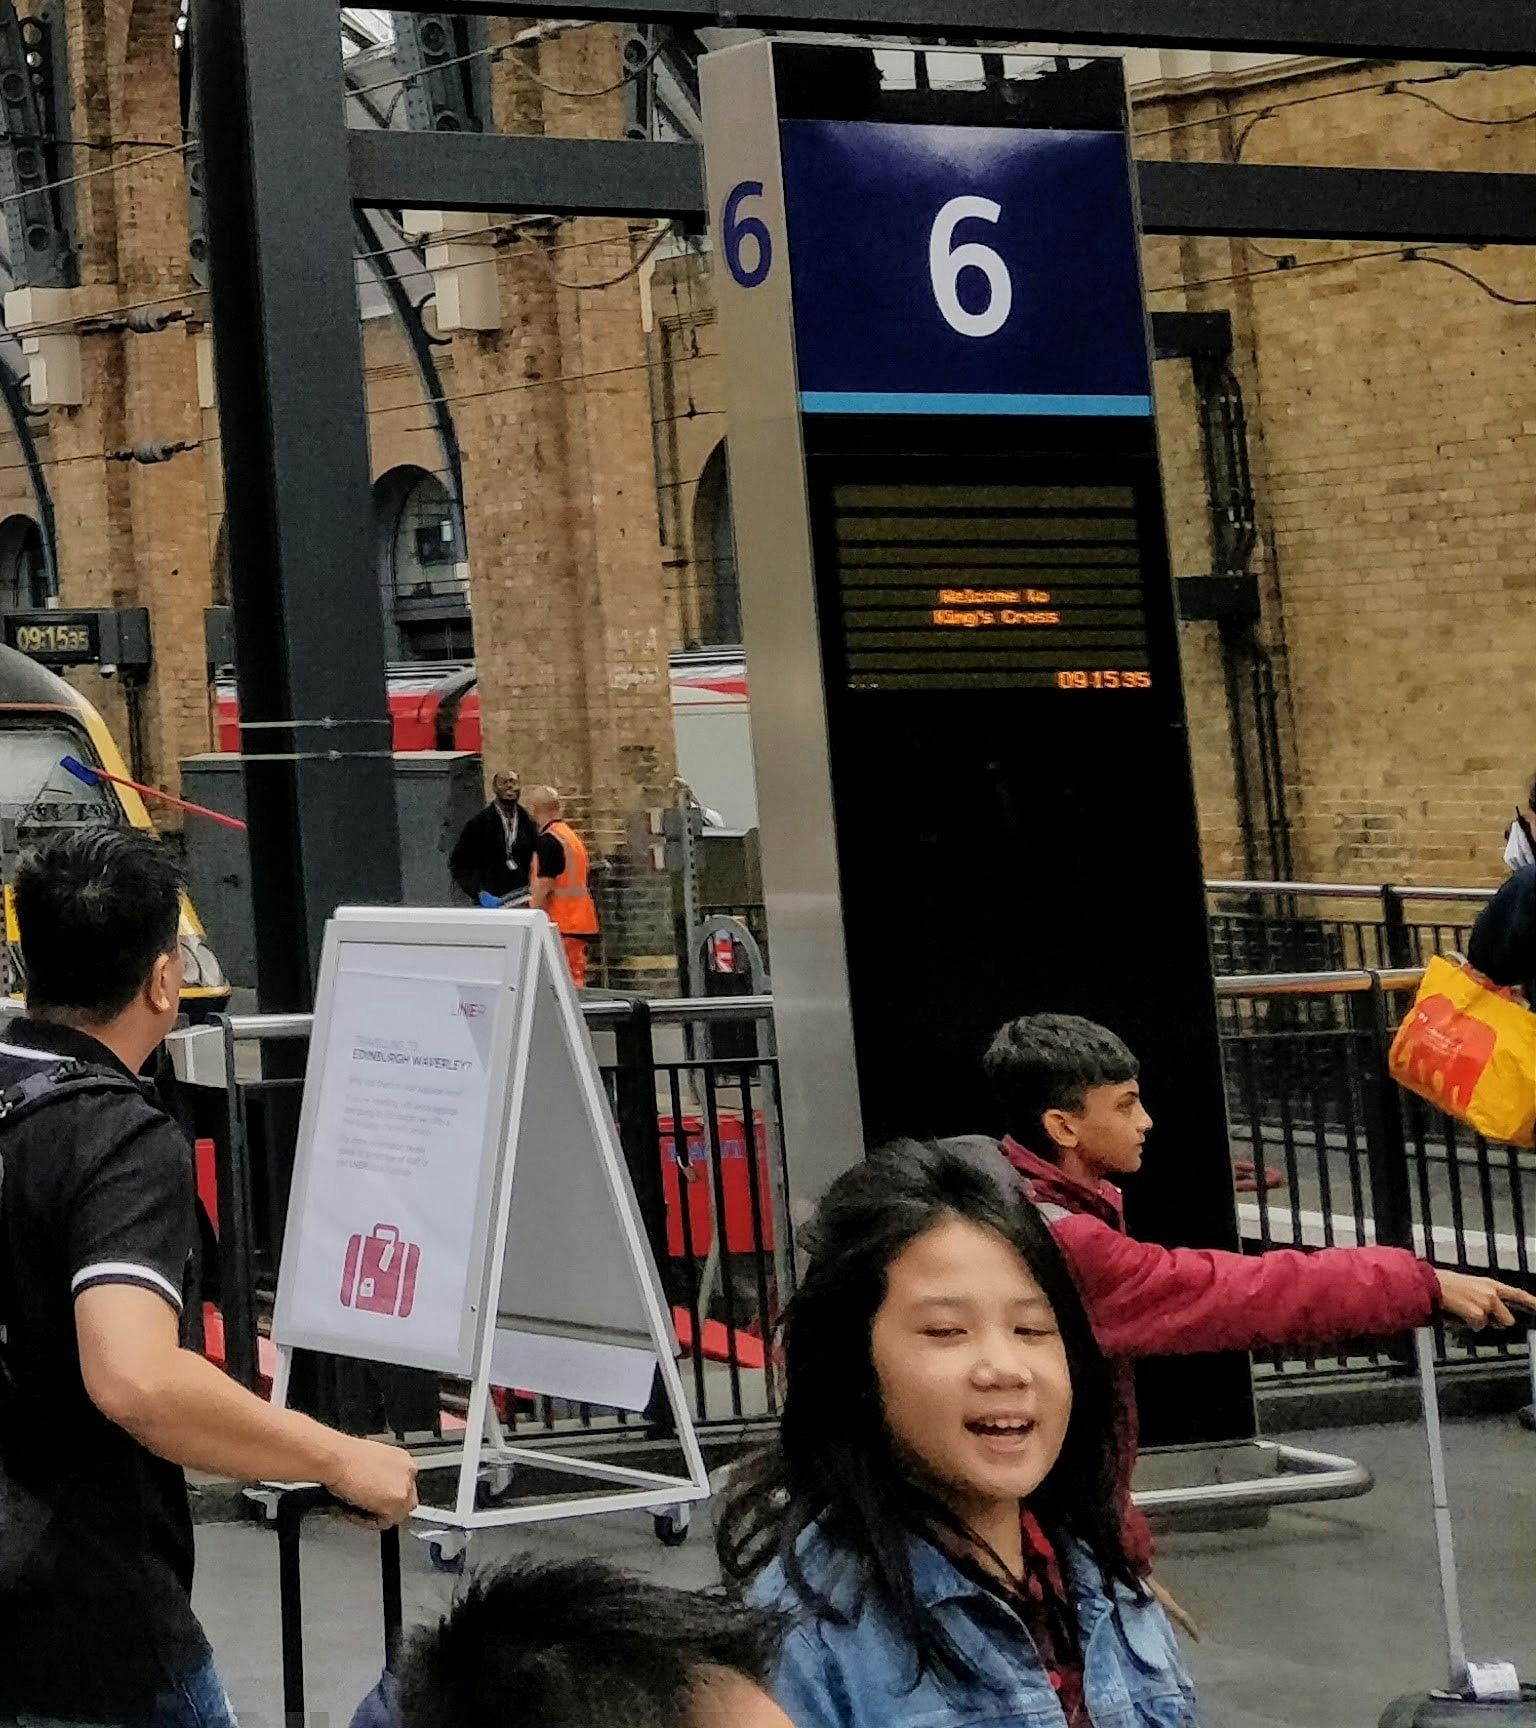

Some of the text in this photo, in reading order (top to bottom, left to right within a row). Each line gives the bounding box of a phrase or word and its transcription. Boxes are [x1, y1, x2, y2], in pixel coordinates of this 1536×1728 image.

[723, 180, 772, 288] 6
[930, 195, 1013, 338] 6
[1000, 610, 1060, 625] Cross
[352, 1048, 473, 1071] EDINBURGH WAVERLEY?
